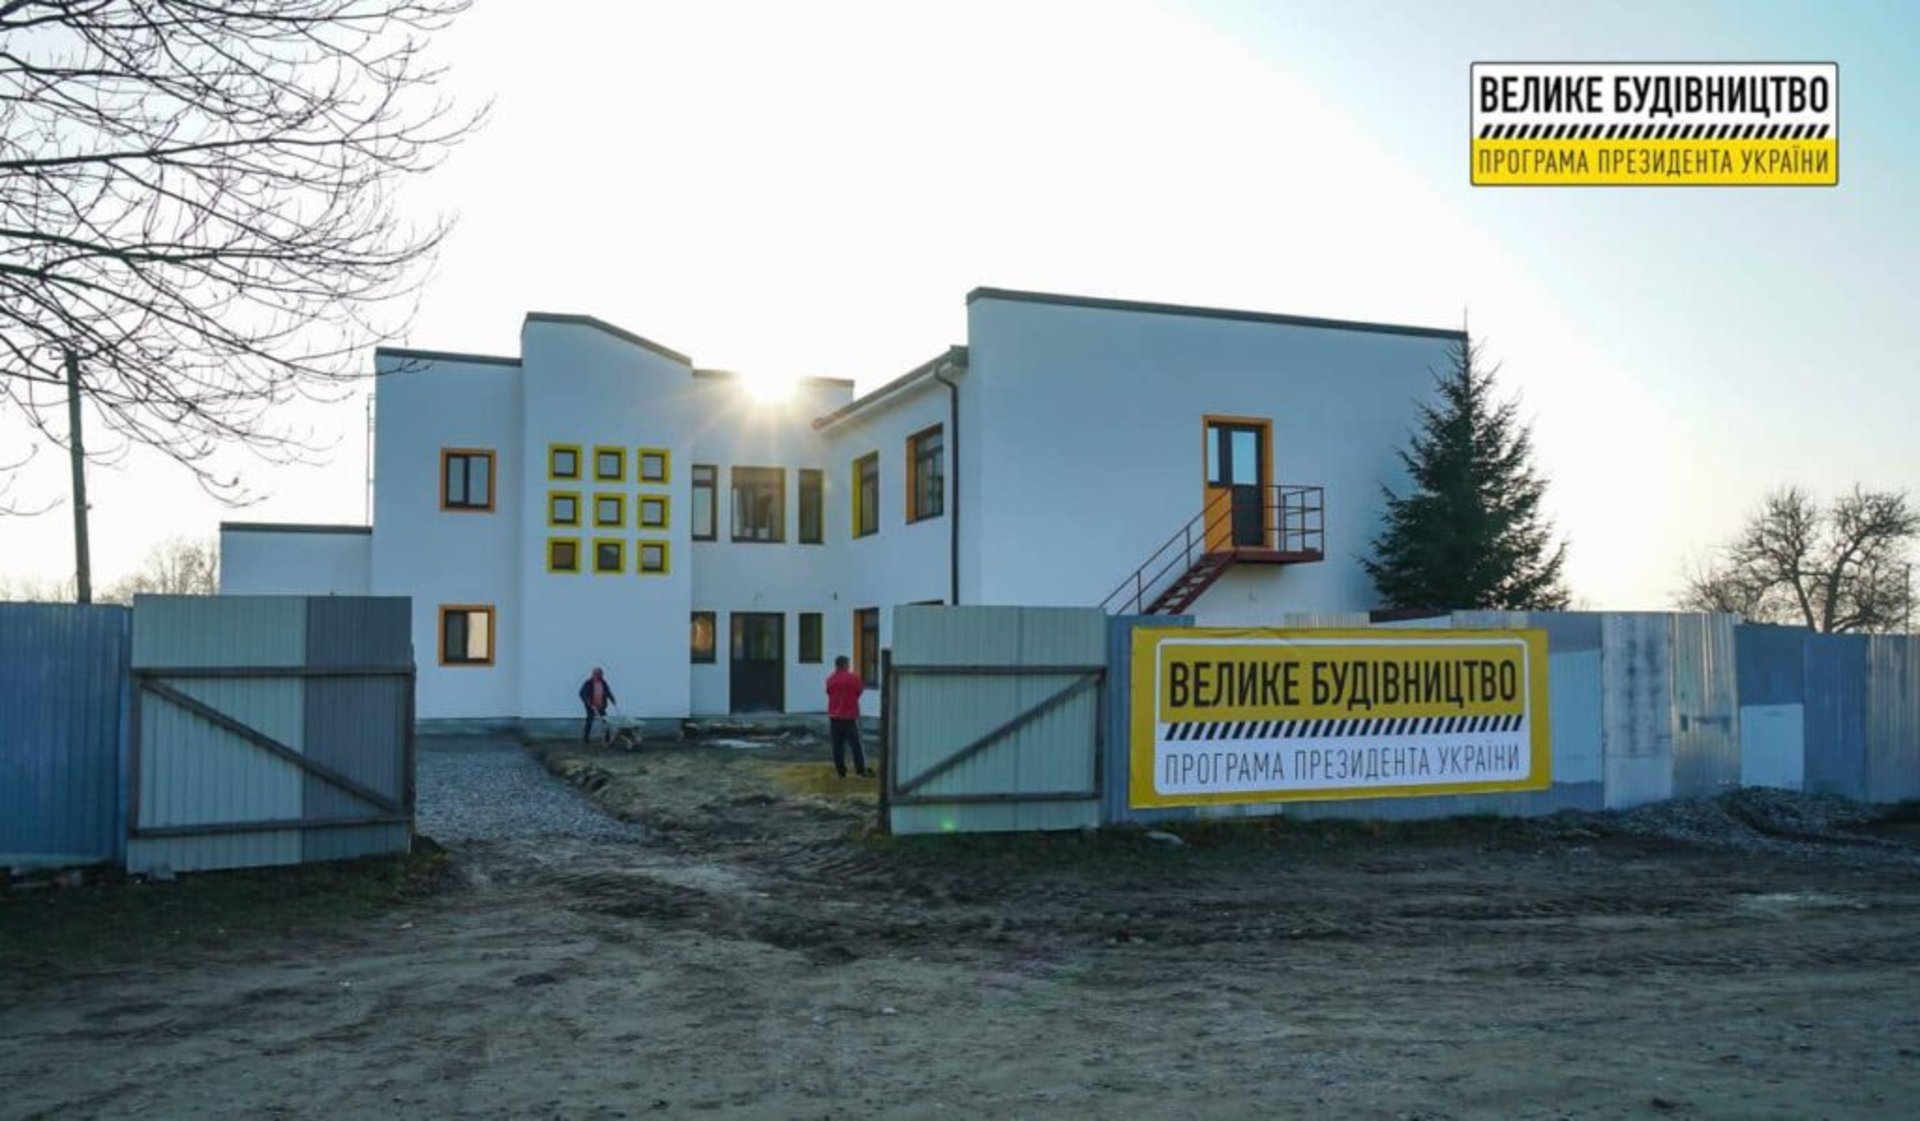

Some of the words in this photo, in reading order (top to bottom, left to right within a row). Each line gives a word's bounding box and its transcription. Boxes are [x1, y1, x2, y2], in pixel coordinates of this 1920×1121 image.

[1169, 661, 1300, 708] ВЕЛИКЕ
[1312, 659, 1516, 710] БУДІВНИЦТВО
[1165, 752, 1284, 785] ПРОГРАМА
[1295, 746, 1430, 781] ПРЕЗИДЕНТА
